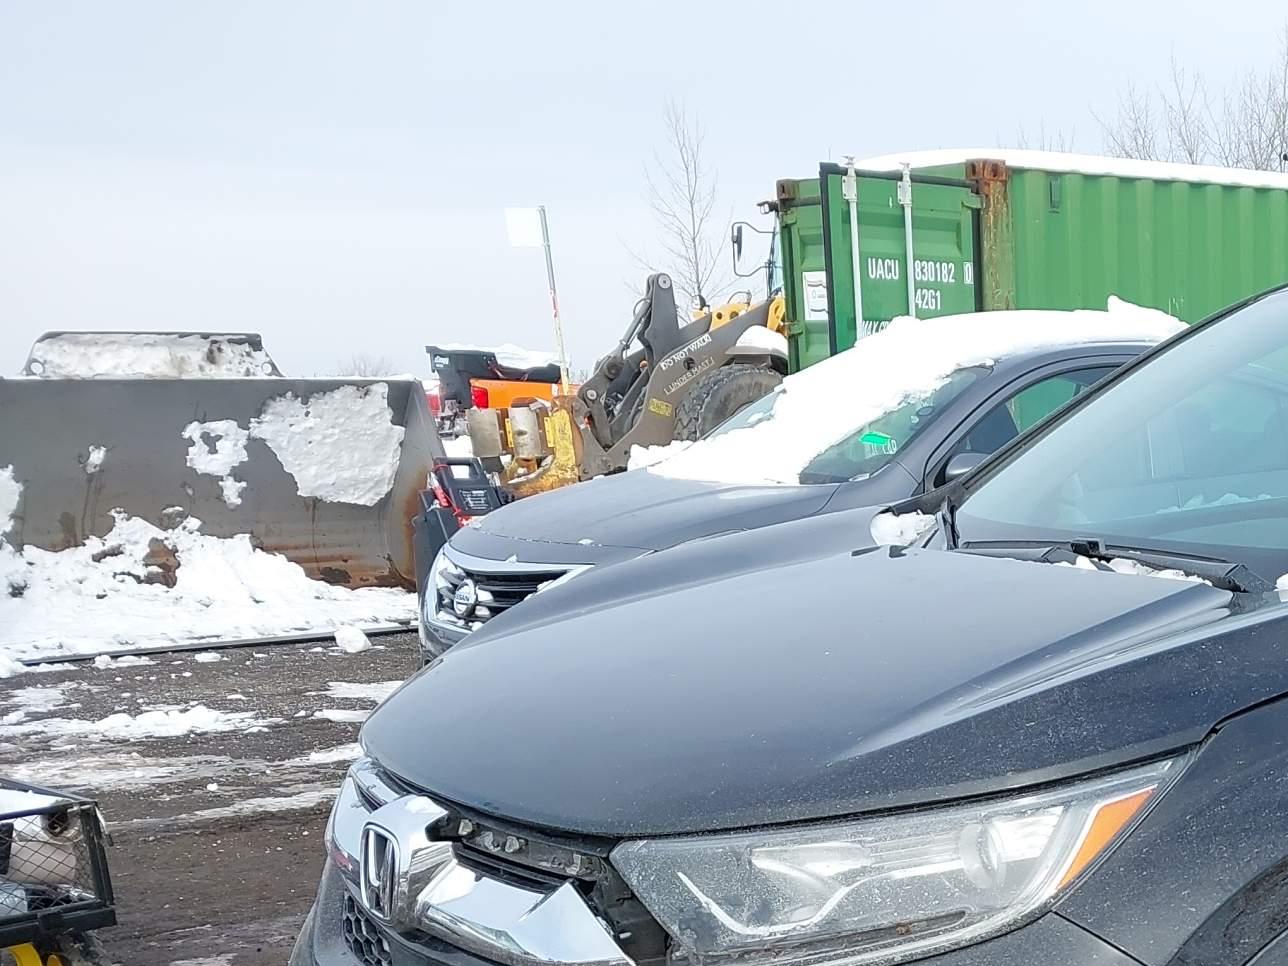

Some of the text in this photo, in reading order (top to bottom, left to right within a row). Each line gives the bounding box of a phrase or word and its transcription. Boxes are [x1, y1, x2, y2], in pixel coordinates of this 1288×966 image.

[867, 257, 899, 281] UACU
[914, 260, 955, 283] 830182
[915, 289, 941, 311] 42G1
[660, 333, 711, 371] DO NOT WALK
[668, 359, 711, 390] UNDER MAST
